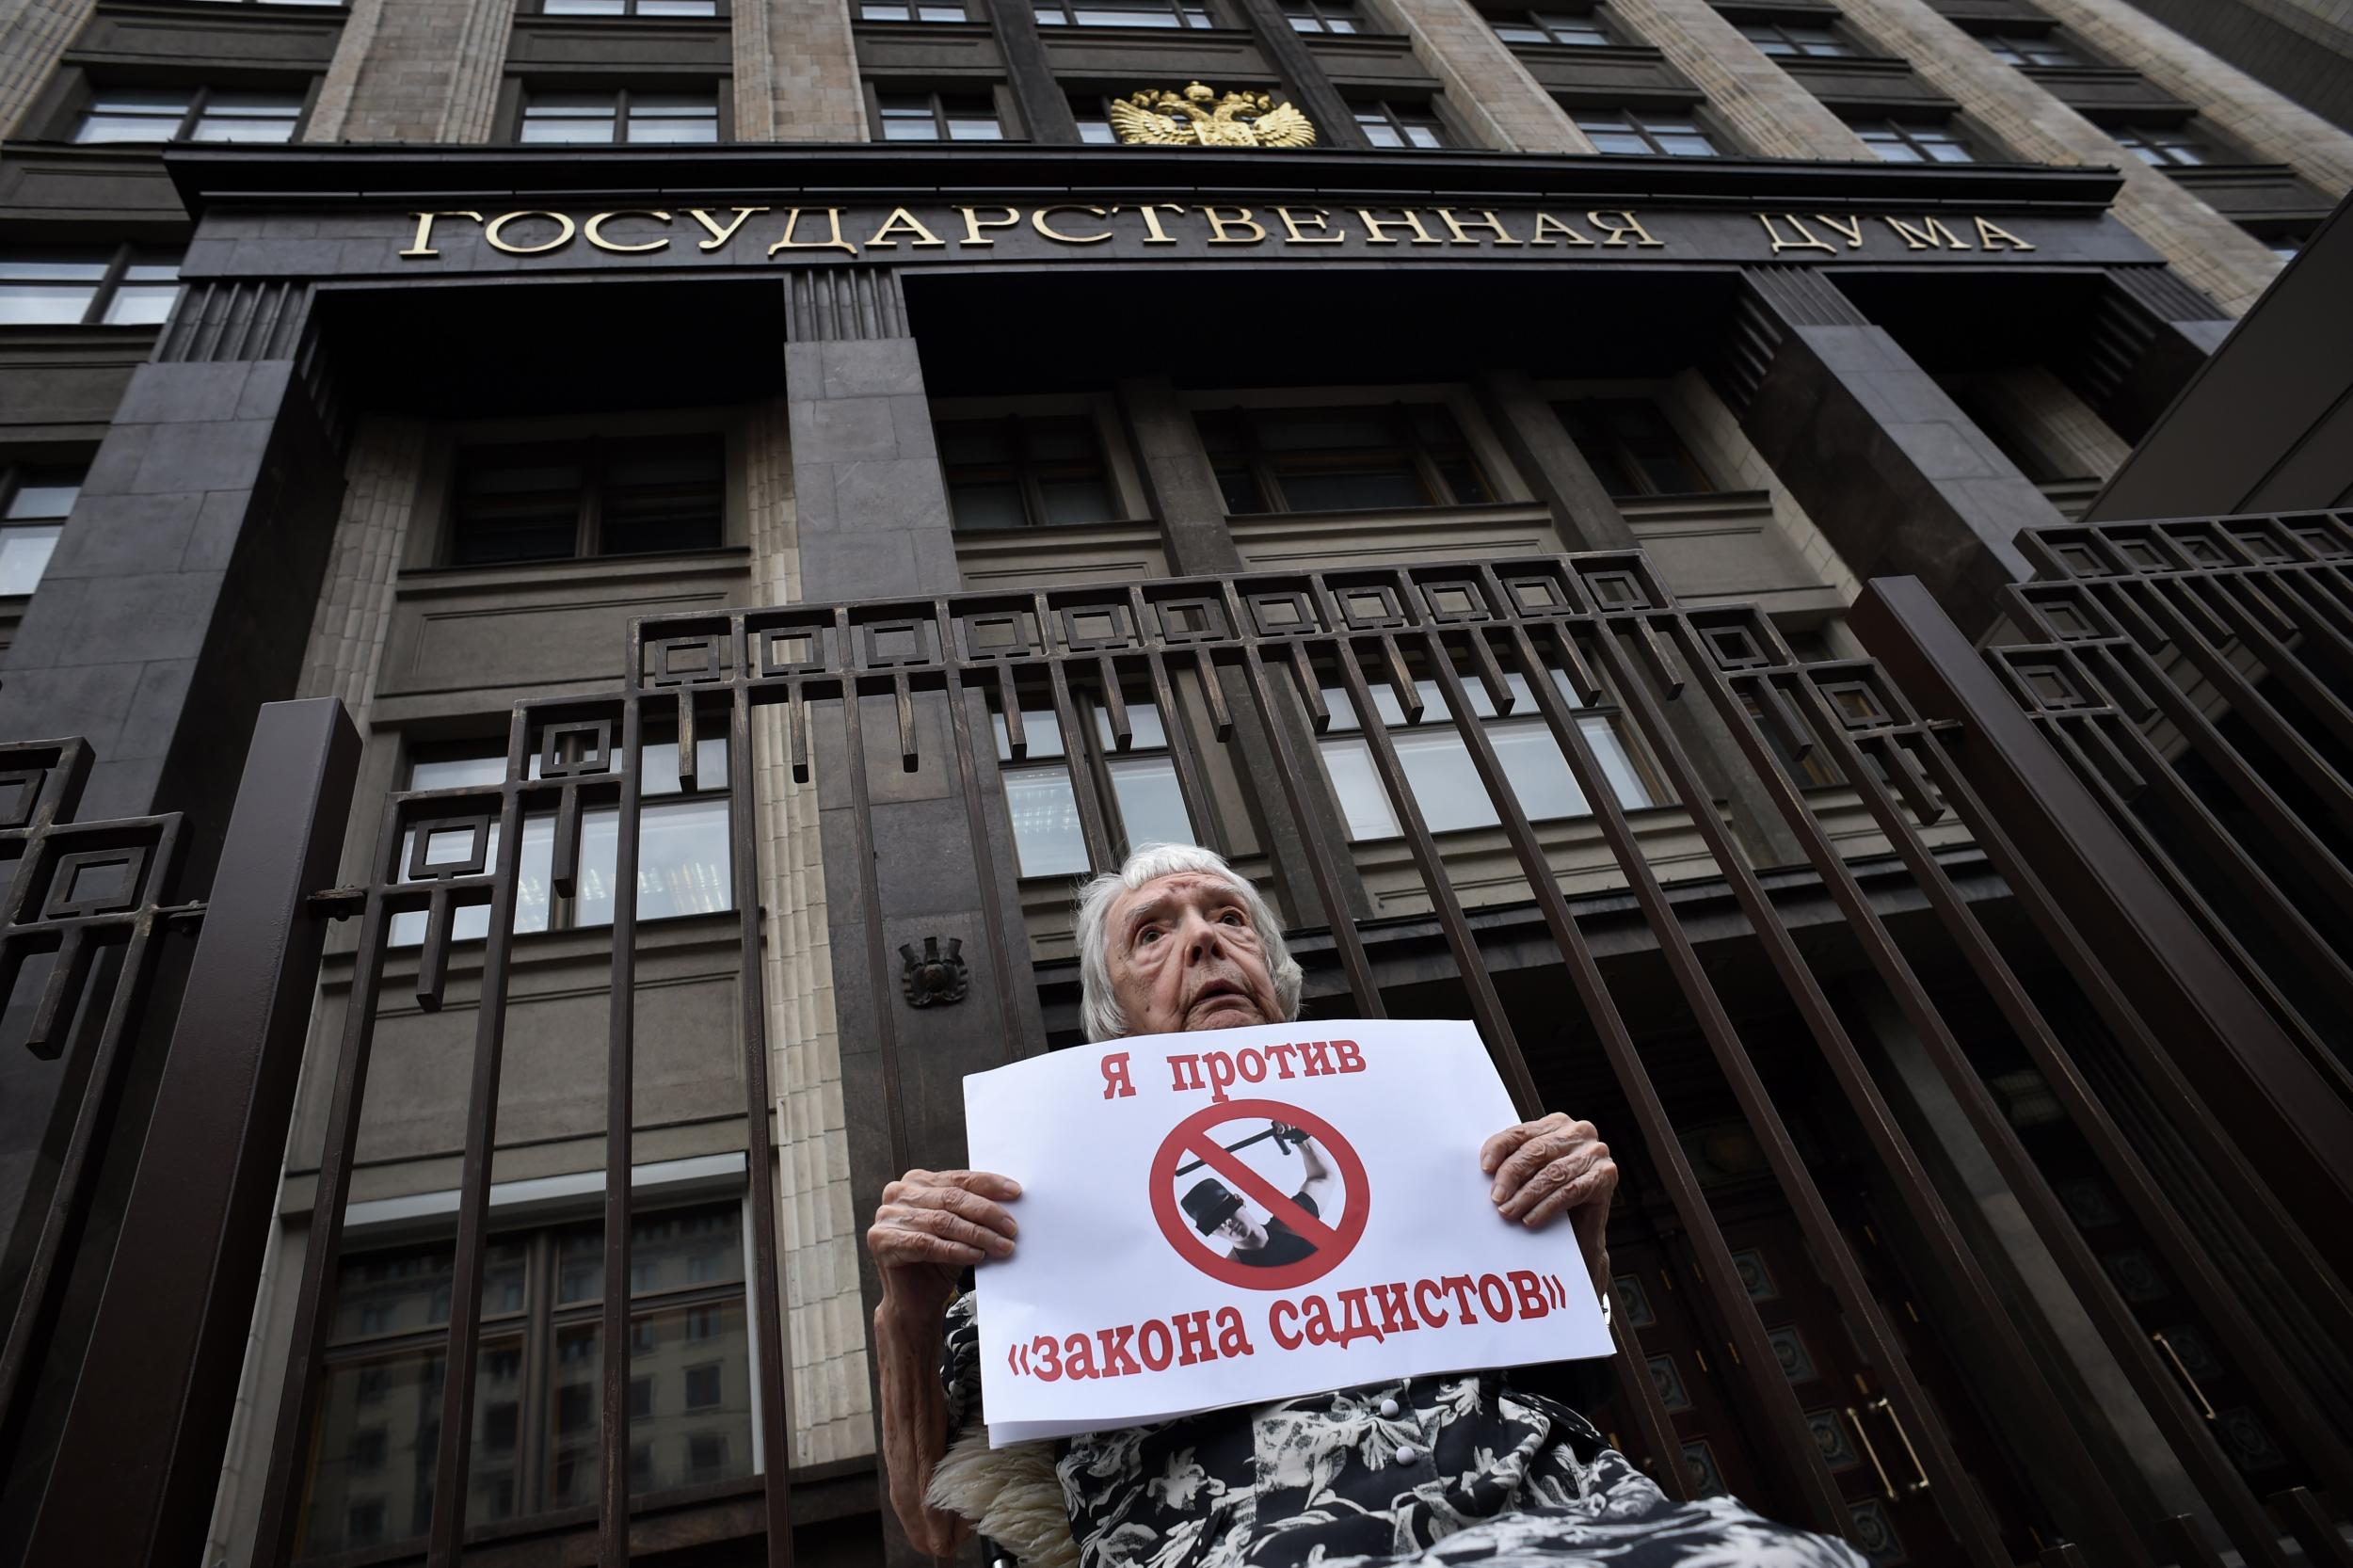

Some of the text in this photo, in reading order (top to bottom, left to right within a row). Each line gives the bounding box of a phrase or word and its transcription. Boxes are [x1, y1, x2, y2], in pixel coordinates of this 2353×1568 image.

[399, 204, 2036, 257] ГОСУДАРСТВЕННАЯ ДУМА
[1100, 1039, 1367, 1103] Я против
[1007, 1270, 1567, 1383] «закона садистов»
